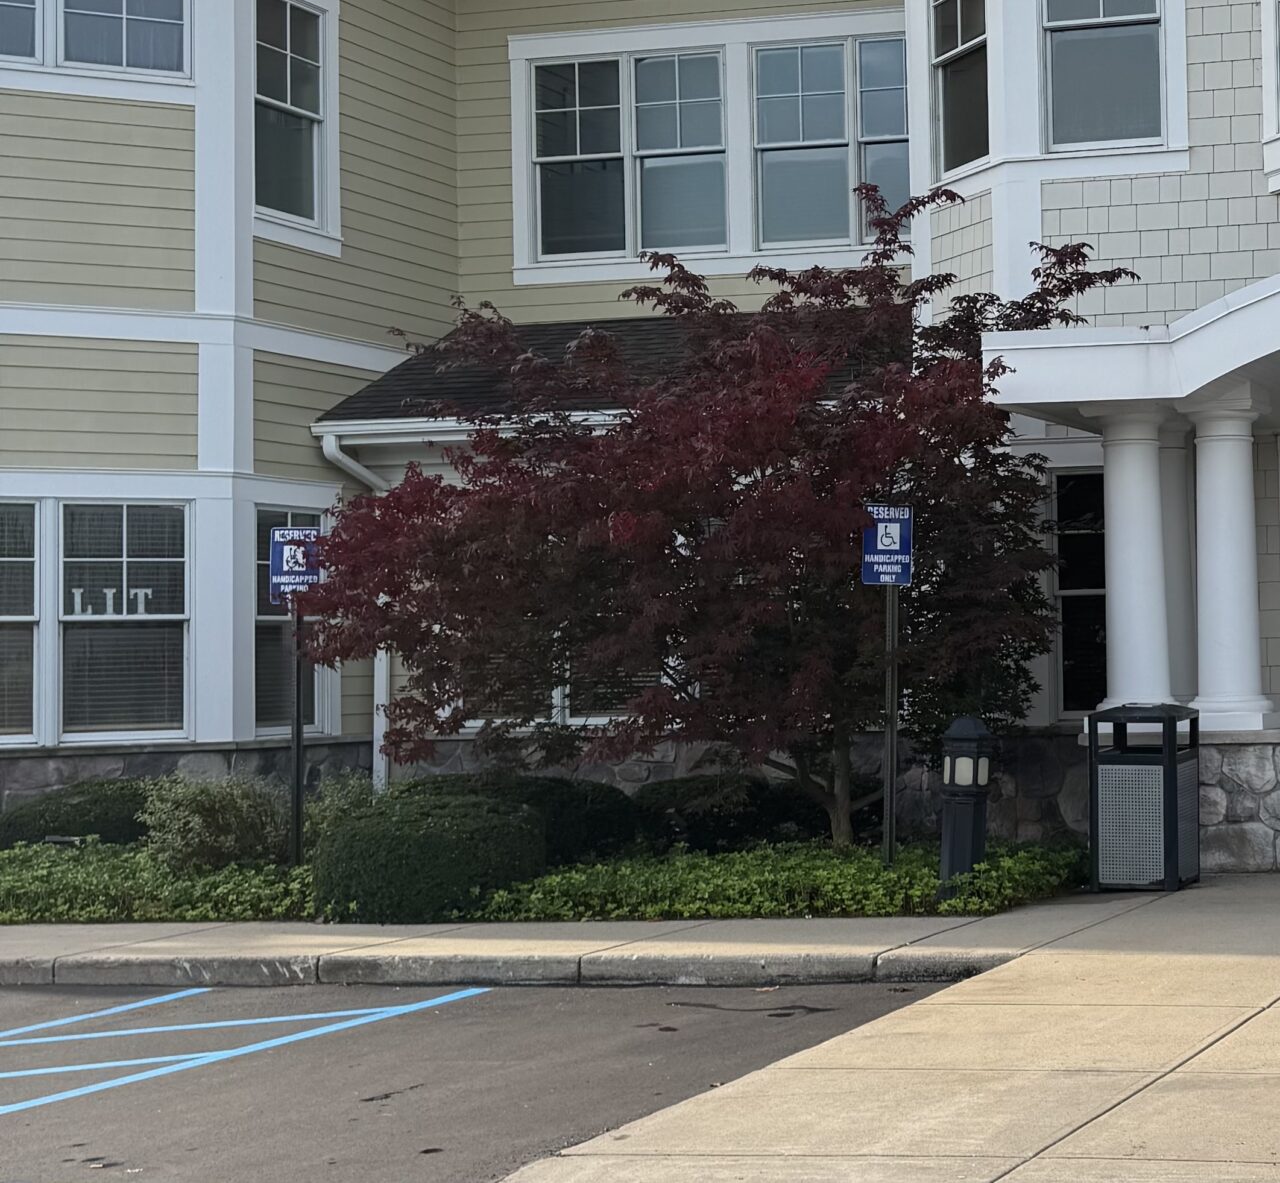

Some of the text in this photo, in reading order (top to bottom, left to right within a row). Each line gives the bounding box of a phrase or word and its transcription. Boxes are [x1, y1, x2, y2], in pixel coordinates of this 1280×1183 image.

[274, 530, 318, 542] RESERVED
[864, 554, 910, 563] HANDICAPPED
[873, 564, 902, 573] PARKING
[272, 575, 318, 584] HANDICAPPED
[880, 574, 896, 583] ONLY
[71, 588, 153, 616] LIT
